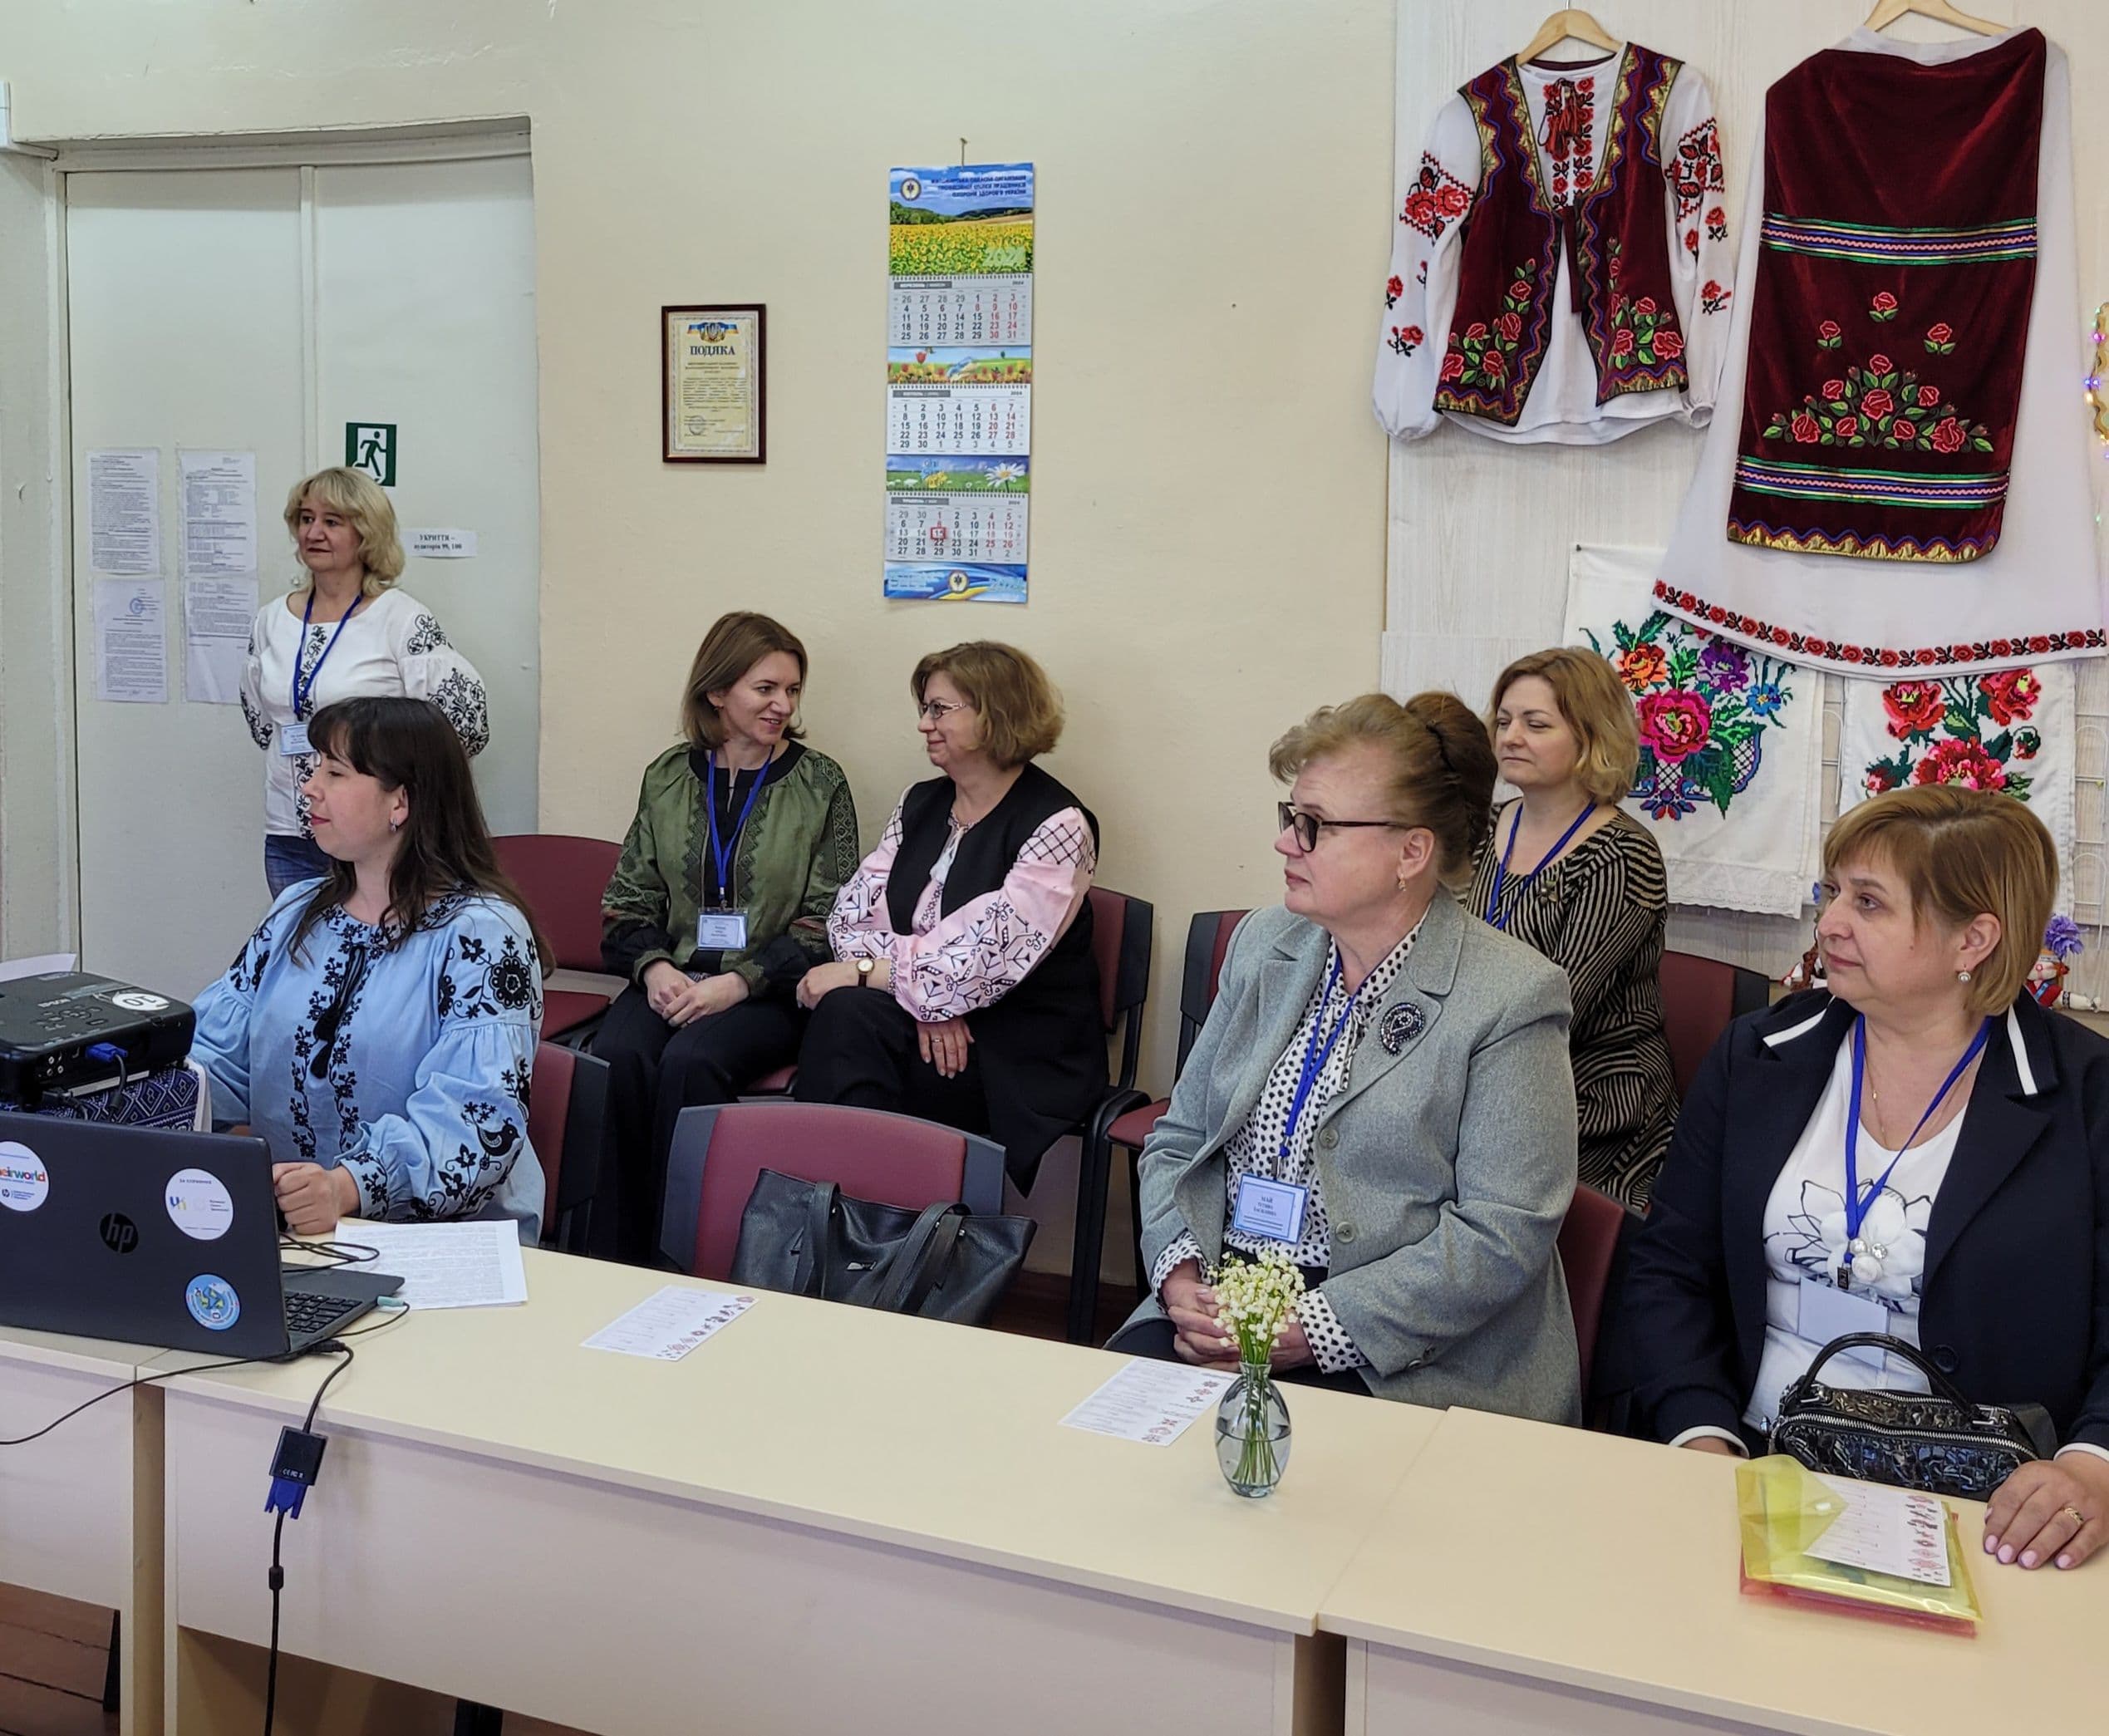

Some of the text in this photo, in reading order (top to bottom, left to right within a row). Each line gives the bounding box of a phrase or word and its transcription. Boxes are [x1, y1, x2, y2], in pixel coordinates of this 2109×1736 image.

[902, 295, 912, 304] 26
[956, 295, 965, 303] 29
[993, 294, 997, 302] 2
[1011, 293, 1015, 301] 3
[922, 304, 927, 312] 5
[1009, 302, 1018, 310] 10
[1009, 312, 1017, 320] 17
[990, 321, 999, 330] 23
[690, 346, 735, 356] ПОДЯКА
[990, 413, 998, 421] 13
[1005, 431, 1015, 439] 28
[1008, 440, 1013, 448] 5
[972, 512, 977, 520] 3
[952, 539, 961, 547] 23
[986, 539, 995, 548] 25
[1003, 540, 1013, 548] 26
[106, 1213, 133, 1252] hp
